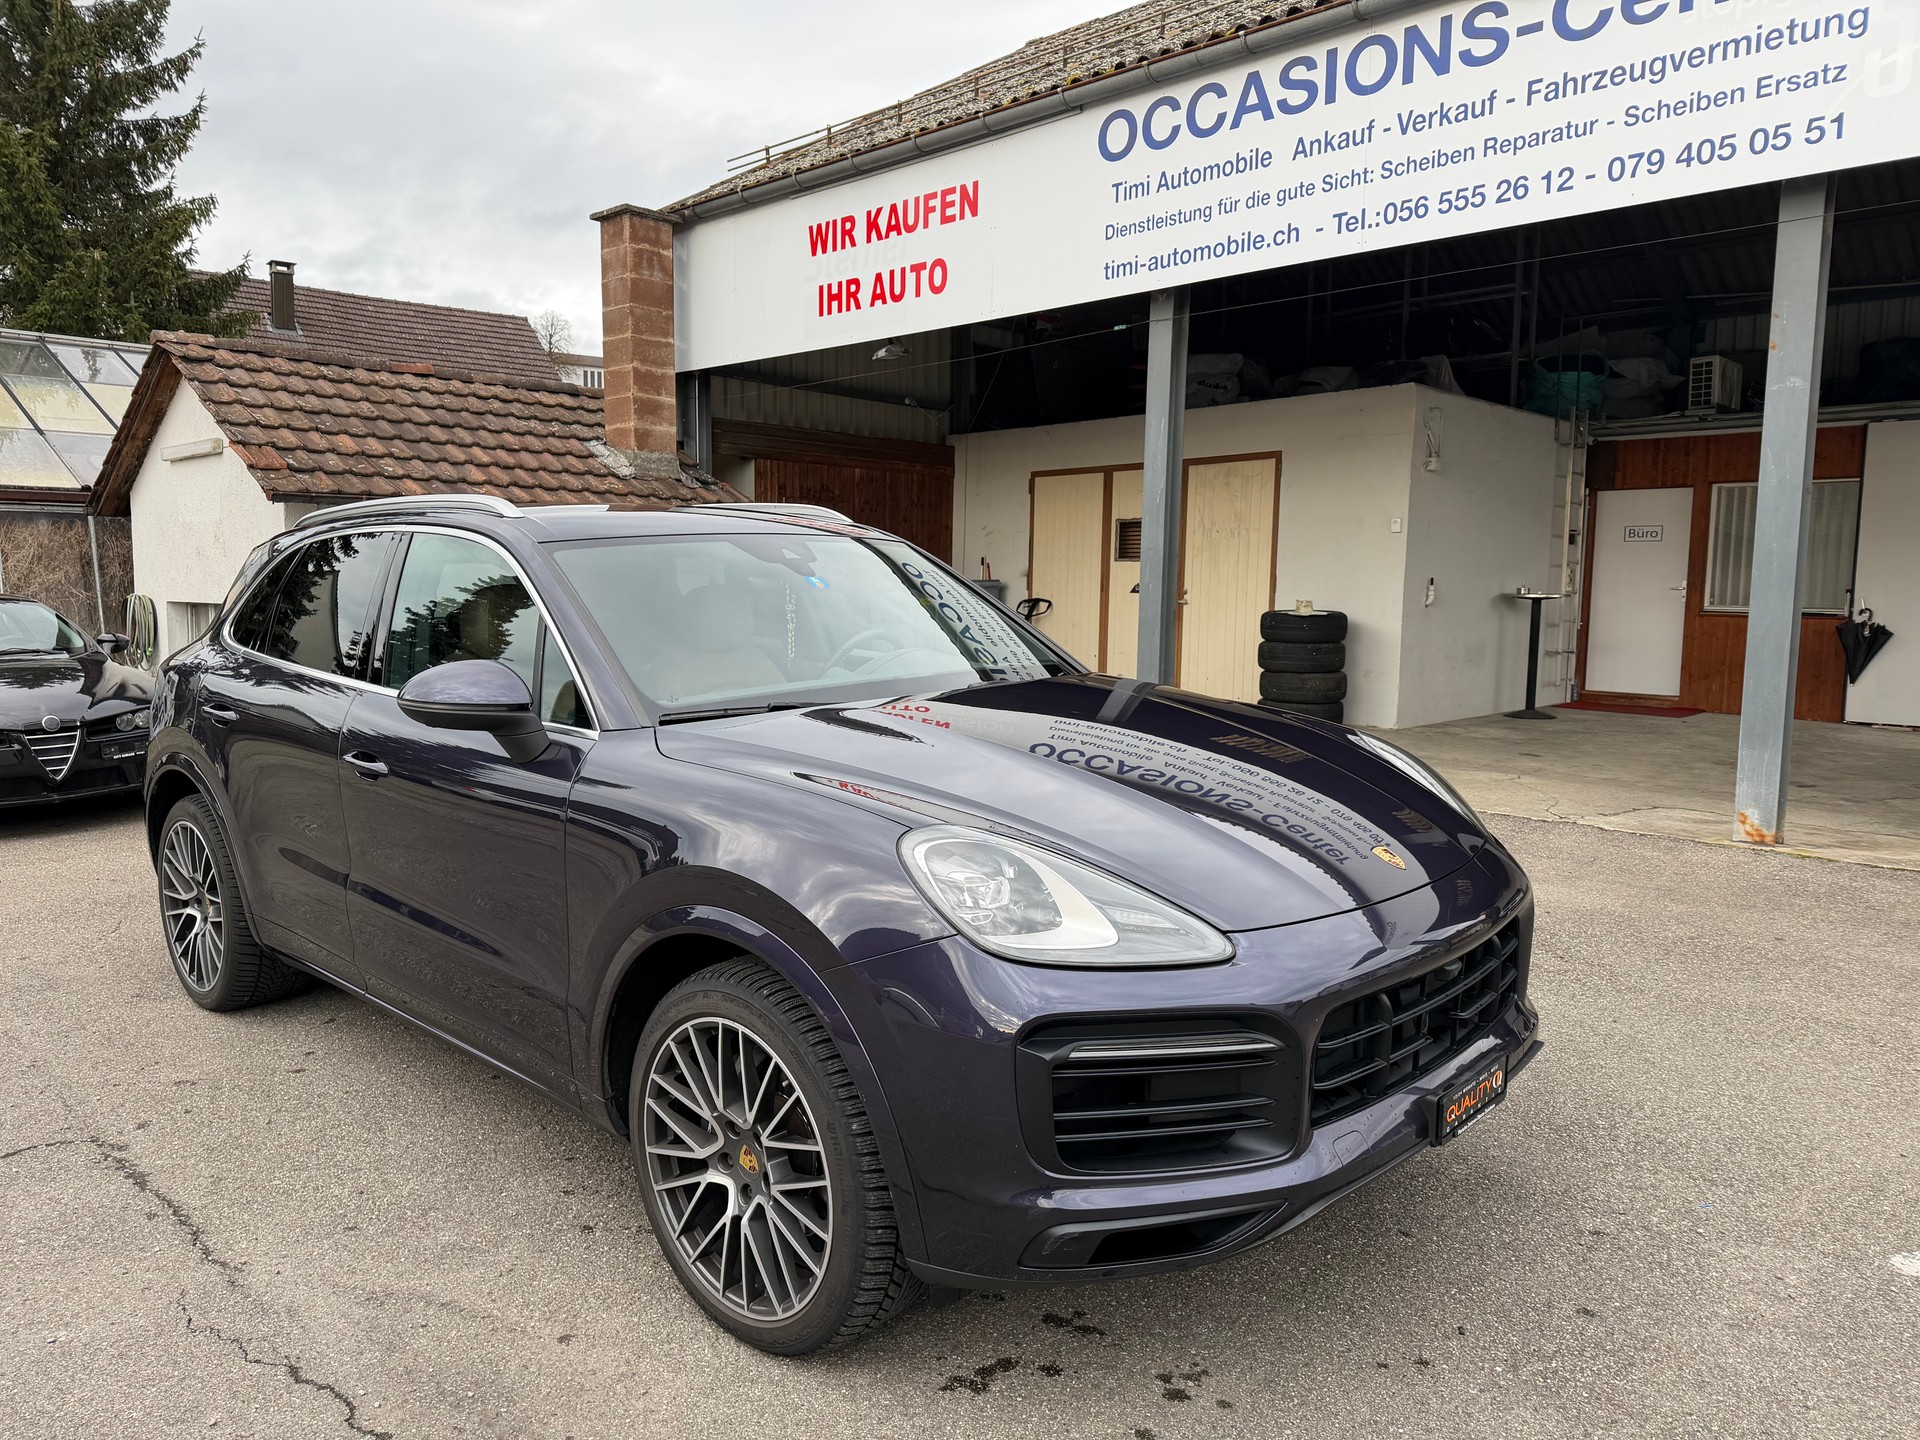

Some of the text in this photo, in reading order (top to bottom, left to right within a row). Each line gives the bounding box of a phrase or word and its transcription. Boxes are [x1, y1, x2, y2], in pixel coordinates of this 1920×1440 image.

[1098, 0, 1734, 162] OCCASIONS-C
[1105, 203, 1213, 241] Dienstleistung
[1217, 196, 1241, 220] für
[1245, 190, 1271, 211] die
[1276, 181, 1316, 207] gute
[1321, 167, 1375, 193] Sicht:
[1380, 146, 1475, 180] Scheiben
[1483, 118, 1599, 158] Reparatur
[1623, 86, 1746, 127] Scheiben
[1756, 63, 1848, 99] Ersatz
[1112, 174, 1151, 204] Timi
[1156, 147, 1273, 194] Automobile
[1291, 118, 1376, 161] Ankauf
[1397, 88, 1498, 137] Verkauf
[1526, 6, 1870, 107] Fahrzeugvermietung
[808, 214, 858, 258] WIR
[865, 179, 980, 245] KAUFEN
[1103, 222, 1300, 281] timi-automobile.ch
[1332, 195, 1429, 236] Tel.:056
[1437, 183, 1487, 215] 555
[1495, 175, 1530, 205] 26
[1540, 166, 1575, 195] 12
[1607, 148, 1665, 182] 079
[1675, 133, 1738, 168] 405
[1749, 122, 1792, 155] 05
[1804, 111, 1845, 146] 51
[818, 277, 862, 317] IHR
[869, 257, 949, 308] AUTO
[1628, 528, 1659, 539] Büro
